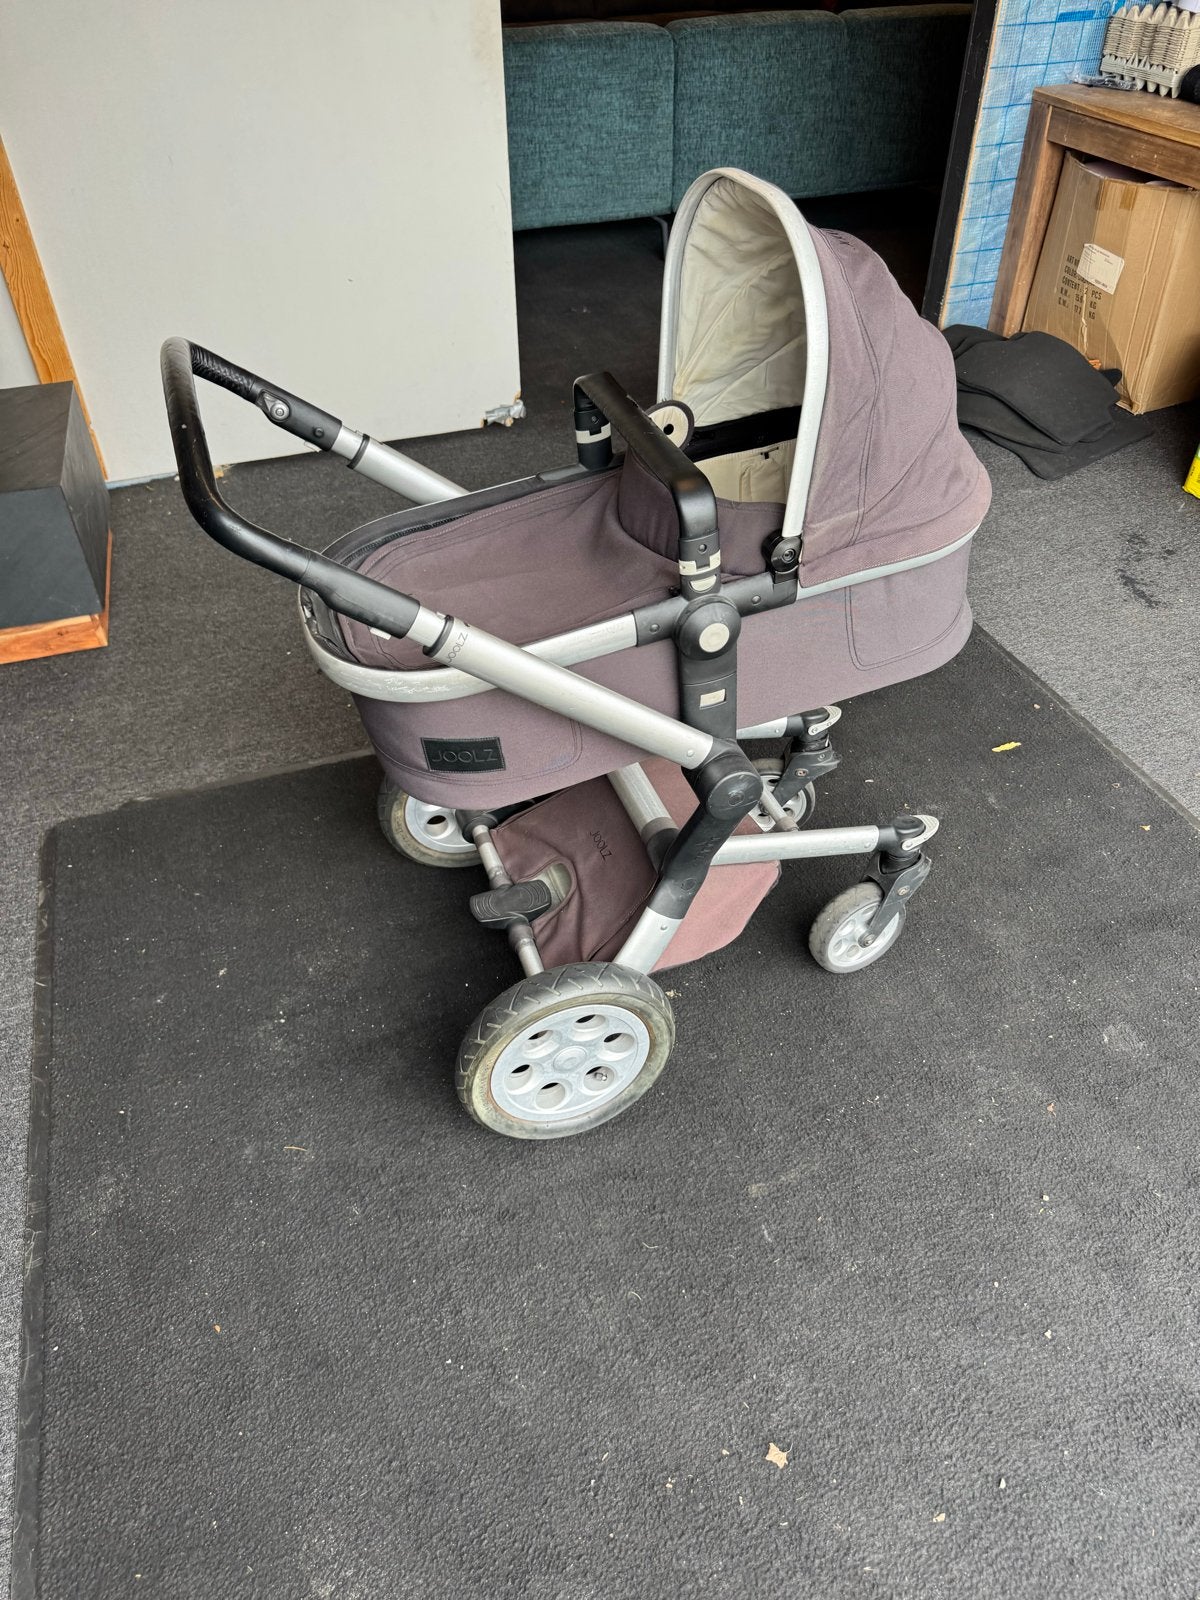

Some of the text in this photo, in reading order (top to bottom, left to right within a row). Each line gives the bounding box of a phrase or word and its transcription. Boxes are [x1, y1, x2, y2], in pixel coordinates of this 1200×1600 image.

[1091, 290, 1102, 300] PCS
[1089, 300, 1097, 310] KG
[1088, 310, 1096, 320] KG
[447, 632, 468, 663] JOOLZ
[431, 748, 499, 763] JOOLZ
[589, 830, 612, 861] JOOLZ
